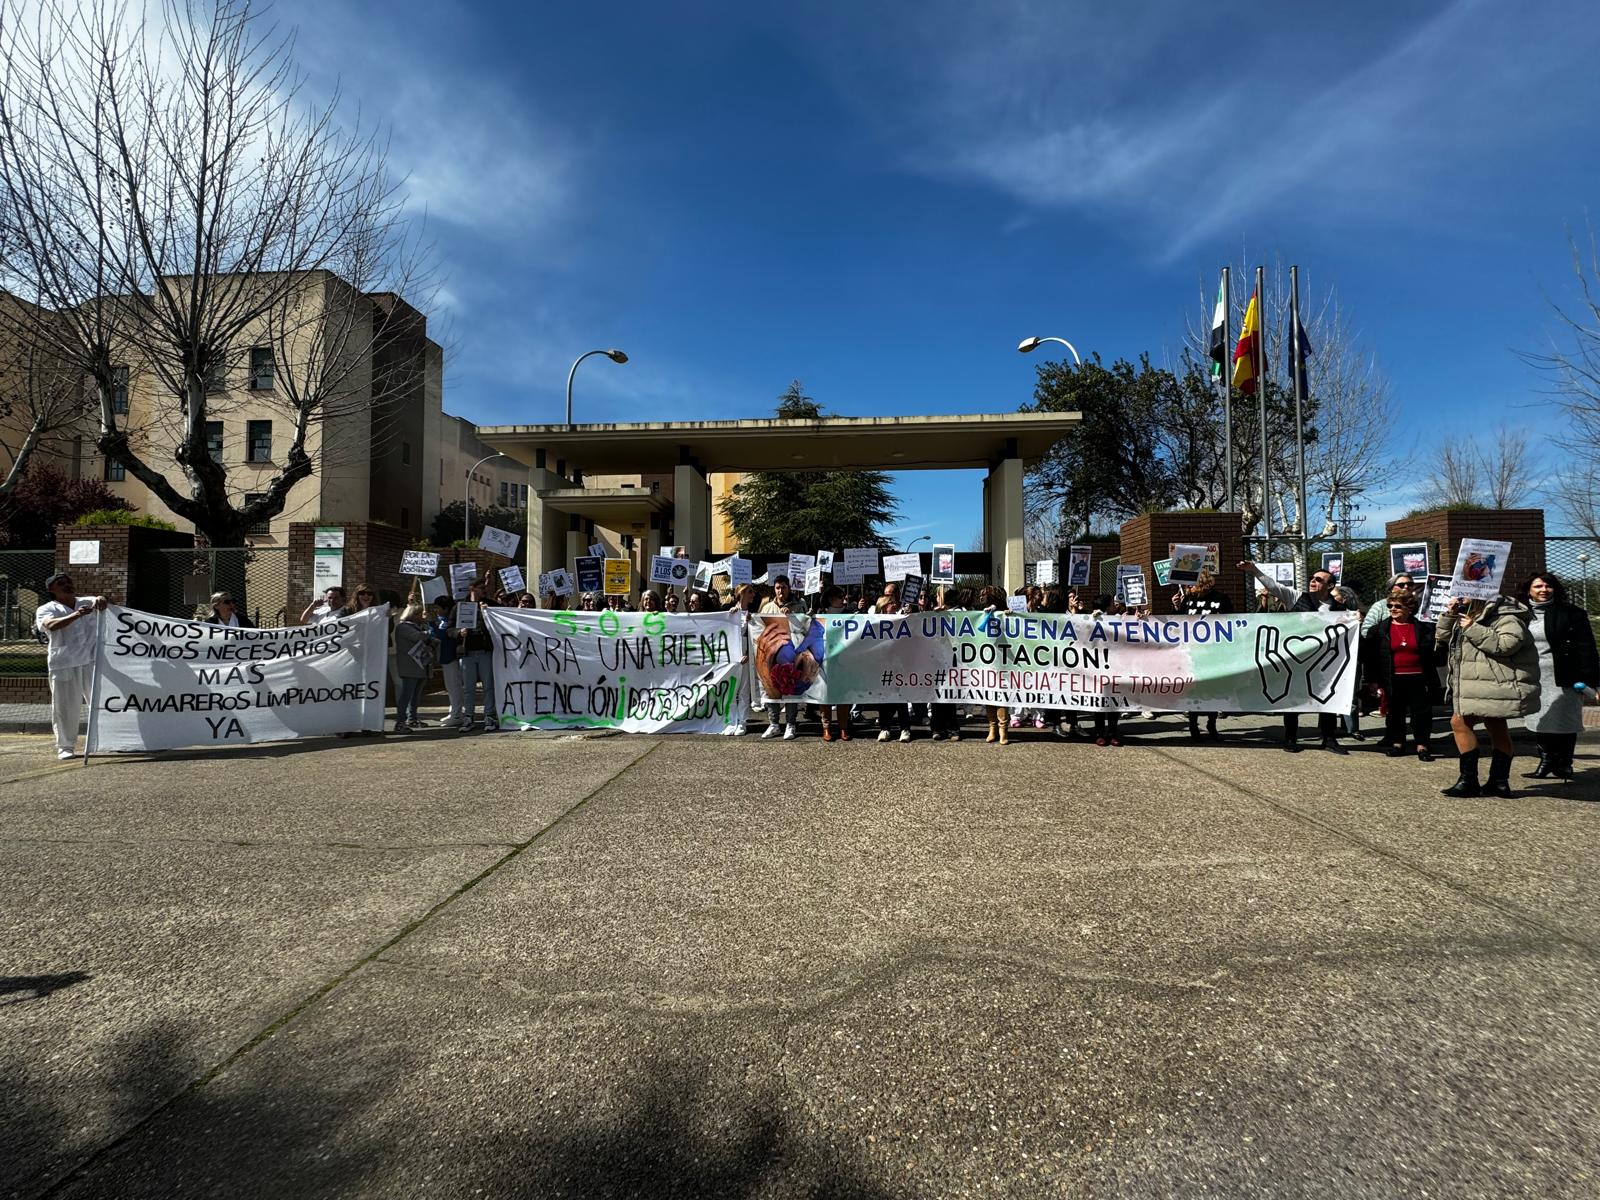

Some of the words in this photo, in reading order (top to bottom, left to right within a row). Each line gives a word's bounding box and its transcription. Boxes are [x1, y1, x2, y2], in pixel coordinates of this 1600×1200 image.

[117, 613, 203, 639] SOMOS
[922, 617, 975, 638] UNA
[987, 617, 1077, 641] BUENA
[113, 635, 199, 660] SOMOS
[501, 633, 581, 675] PARA
[598, 636, 655, 671] UNA
[659, 630, 730, 667] BUENA
[952, 642, 1110, 669] ¡DOTACIÓN!
[198, 662, 265, 685] MÁS
[104, 691, 250, 713] CAMAREROS
[502, 675, 618, 718] ATENCIÓN
[934, 689, 1023, 703] VILLANUEVA
[1026, 692, 1045, 704] DE
[1046, 693, 1066, 705] LA
[205, 716, 245, 739] YA
